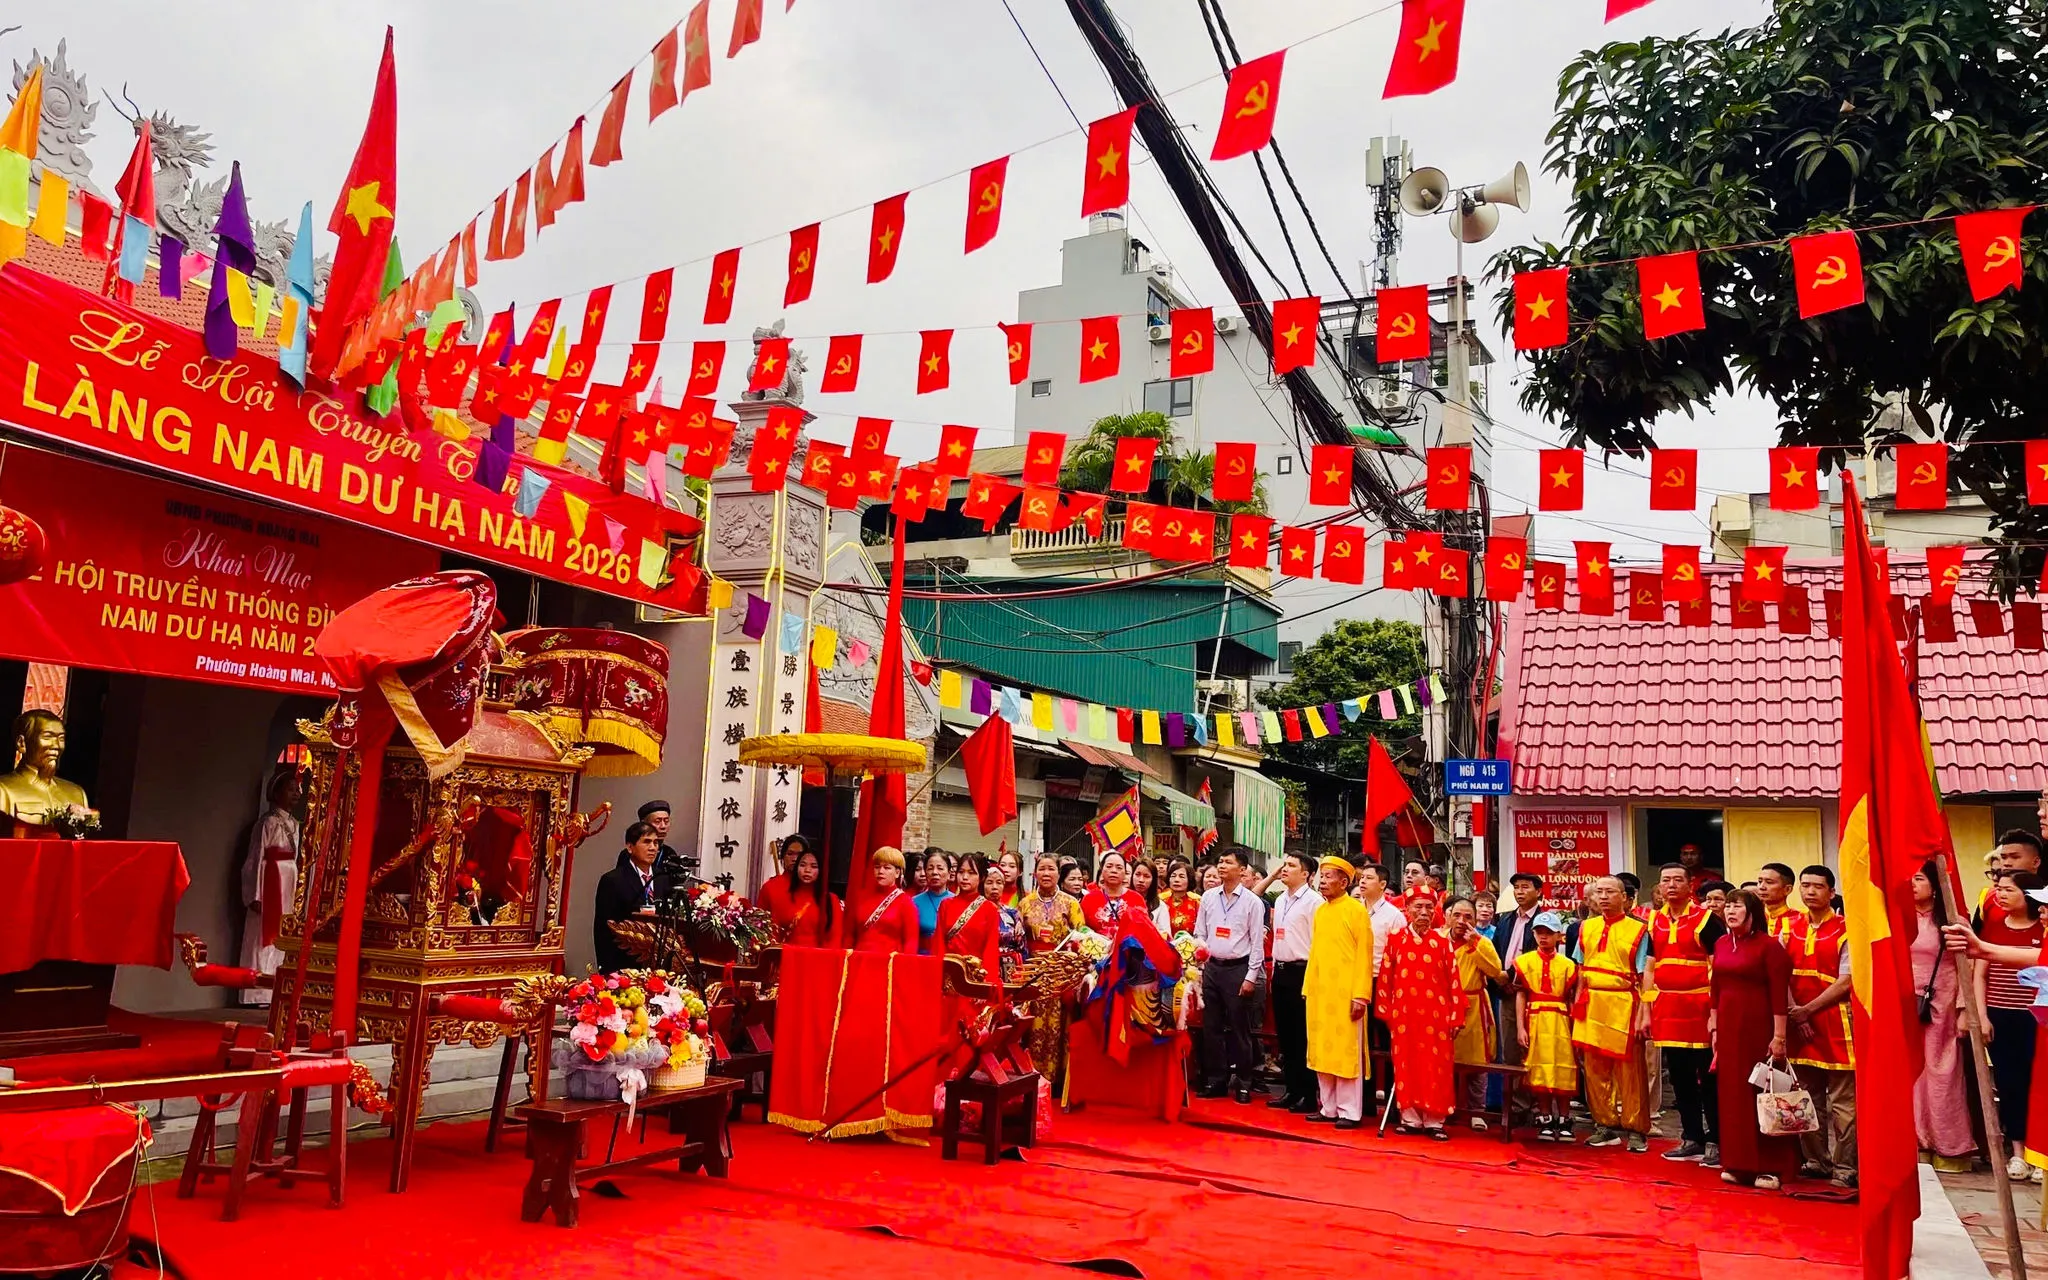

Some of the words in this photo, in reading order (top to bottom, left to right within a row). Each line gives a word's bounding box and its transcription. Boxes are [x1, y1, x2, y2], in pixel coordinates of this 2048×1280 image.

[69, 309, 172, 371] Lễ
[181, 355, 279, 412] Hội
[297, 390, 424, 463] Truyền
[22, 360, 193, 455] LÀNG
[212, 423, 324, 493] NAM
[339, 462, 405, 515] DƯ
[412, 487, 466, 542] HẠ
[479, 502, 556, 563] NĂM
[564, 538, 631, 585] 2026
[163, 527, 245, 577] Khai
[254, 545, 312, 593] Mạc
[54, 559, 105, 594] HỘI
[112, 570, 217, 610] TRUYỀN
[225, 589, 299, 624] THỐNG
[307, 603, 337, 628] ĐÌ
[101, 603, 158, 634] NAM
[166, 614, 206, 640] DƯ
[211, 620, 243, 651] HẠ
[250, 623, 296, 654] NĂM
[195, 655, 247, 677] Phường
[249, 663, 287, 682] Hoàng
[290, 668, 318, 686] Mai,
[1451, 781, 1469, 790] PHỐ
[1470, 782, 1490, 790] NAM
[1459, 763, 1475, 776] NGÕ
[1482, 764, 1496, 776] 415
[1580, 830, 1607, 838] VANG
